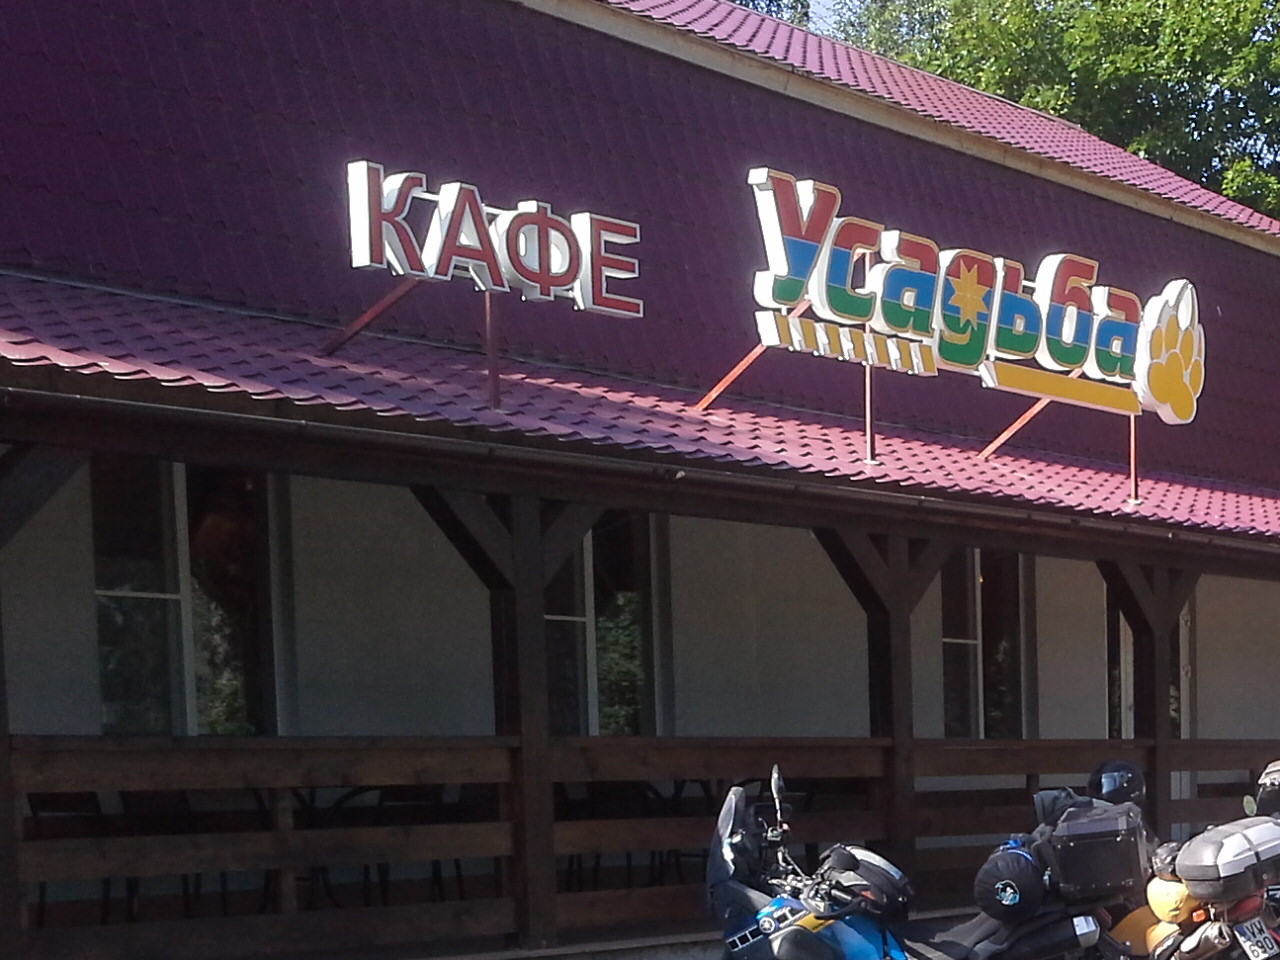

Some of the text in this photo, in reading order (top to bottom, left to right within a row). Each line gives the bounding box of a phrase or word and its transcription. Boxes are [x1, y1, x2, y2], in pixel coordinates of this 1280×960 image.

[347, 159, 1144, 381] КАФЕ Усадьба
[1249, 936, 1274, 959] 690
